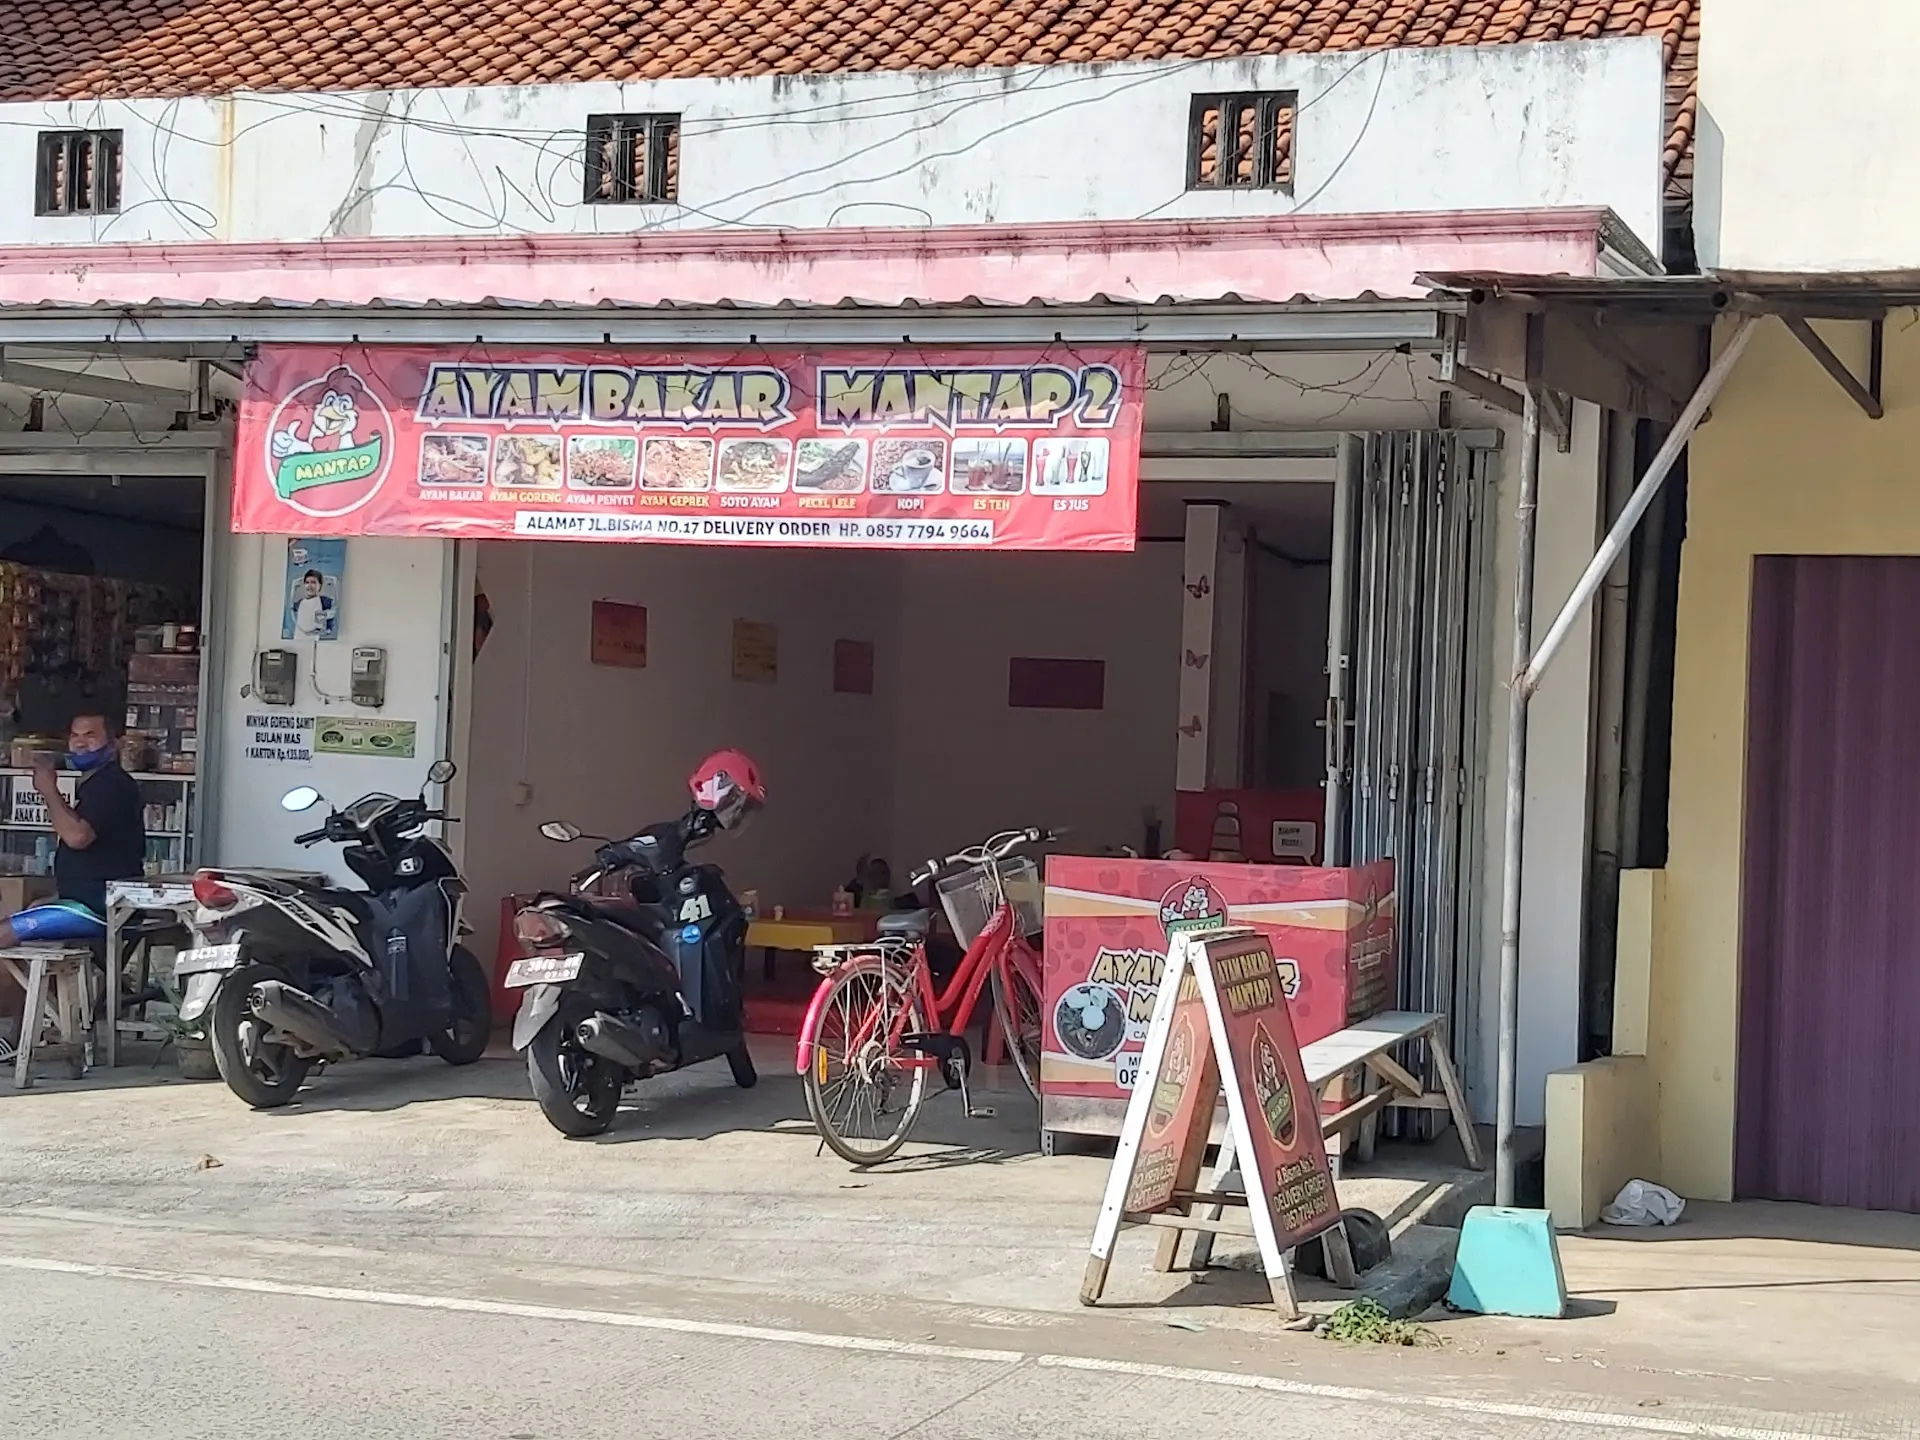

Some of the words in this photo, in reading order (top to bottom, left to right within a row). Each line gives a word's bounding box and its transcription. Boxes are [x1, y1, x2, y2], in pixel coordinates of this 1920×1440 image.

[419, 365, 583, 422] AYAM
[585, 366, 788, 424] BAKAR
[820, 368, 1077, 428] MANTAP
[1077, 366, 1120, 424] 2
[295, 454, 372, 482] MANTAP
[419, 490, 448, 502] AYAM
[448, 490, 484, 502] BAKAR
[489, 491, 519, 503] AYAM
[520, 492, 562, 503] GORENG
[566, 494, 595, 505] AYAM
[597, 495, 635, 506] PENYET
[640, 495, 668, 506] AYAM
[669, 495, 710, 507] GEPREK
[720, 496, 749, 508] SOTO
[750, 497, 780, 508] AYAM
[798, 497, 831, 509] PECEL
[831, 497, 857, 509] LELE
[897, 498, 925, 510] KOPI
[973, 499, 987, 510] ES
[988, 499, 1010, 511] TEH
[1053, 499, 1067, 511] ES
[1068, 499, 1089, 511] JUS
[527, 516, 585, 531] ALAMAT
[657, 520, 700, 535] NO.17
[703, 521, 775, 536] DELIVERY
[779, 522, 831, 537] ORDER
[839, 523, 862, 538] HP.
[865, 524, 902, 539] 0857
[907, 525, 946, 539] 7794
[949, 525, 990, 540] 9664
[246, 715, 269, 728] MINYAK
[270, 716, 295, 729] GORENG
[255, 732, 282, 744] BULAN
[284, 733, 301, 744] MAS
[251, 747, 276, 759] KARTON
[15, 807, 34, 822] ANAK
[35, 809, 42, 822] &
[680, 894, 713, 923] 41
